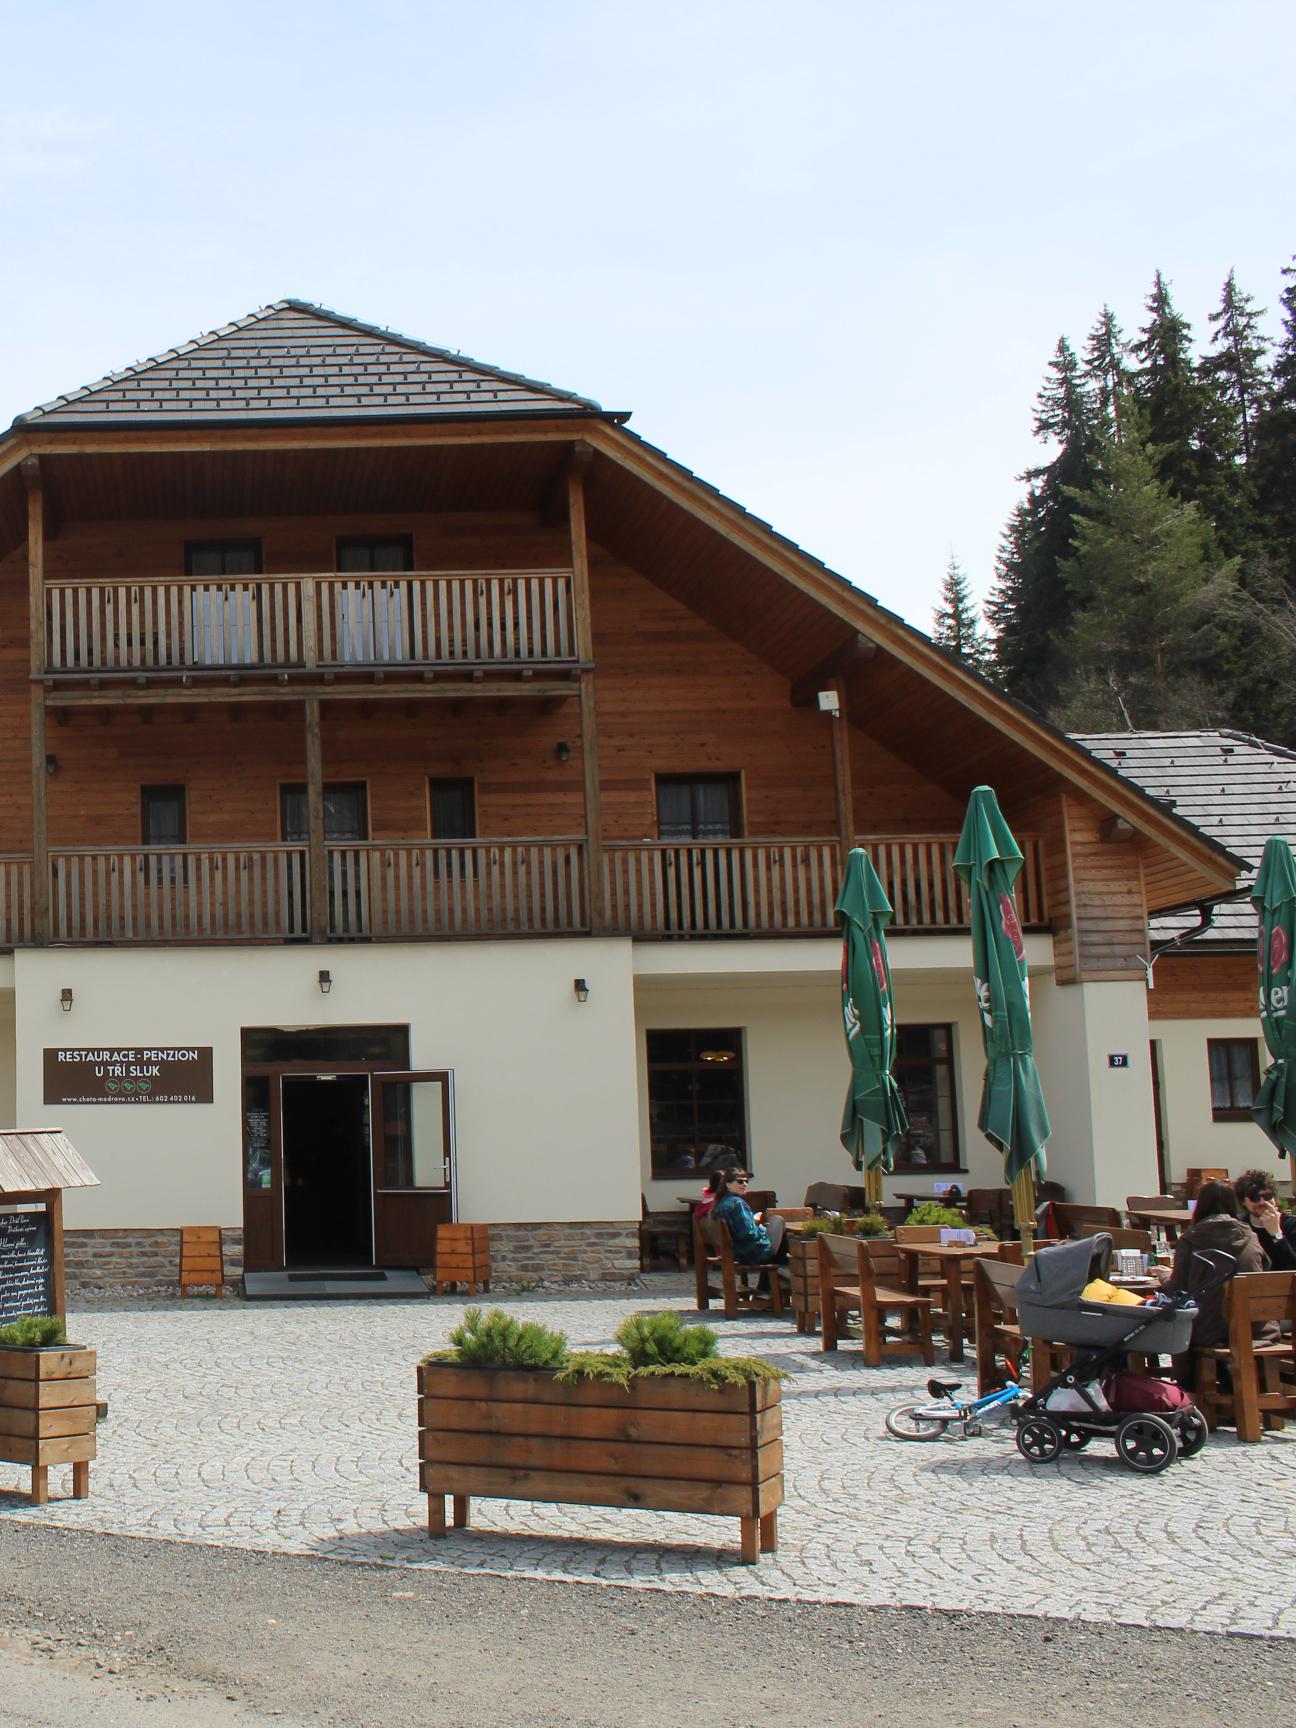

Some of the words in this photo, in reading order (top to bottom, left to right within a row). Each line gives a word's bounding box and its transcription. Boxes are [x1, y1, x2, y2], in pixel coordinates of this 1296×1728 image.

[58, 1050, 135, 1062] RESTAURACE
[143, 1050, 198, 1061] PENZION
[1114, 1056, 1123, 1065] 37
[95, 1066, 103, 1077] U
[107, 1063, 126, 1077] TŘÍ
[129, 1065, 160, 1077] SLUK
